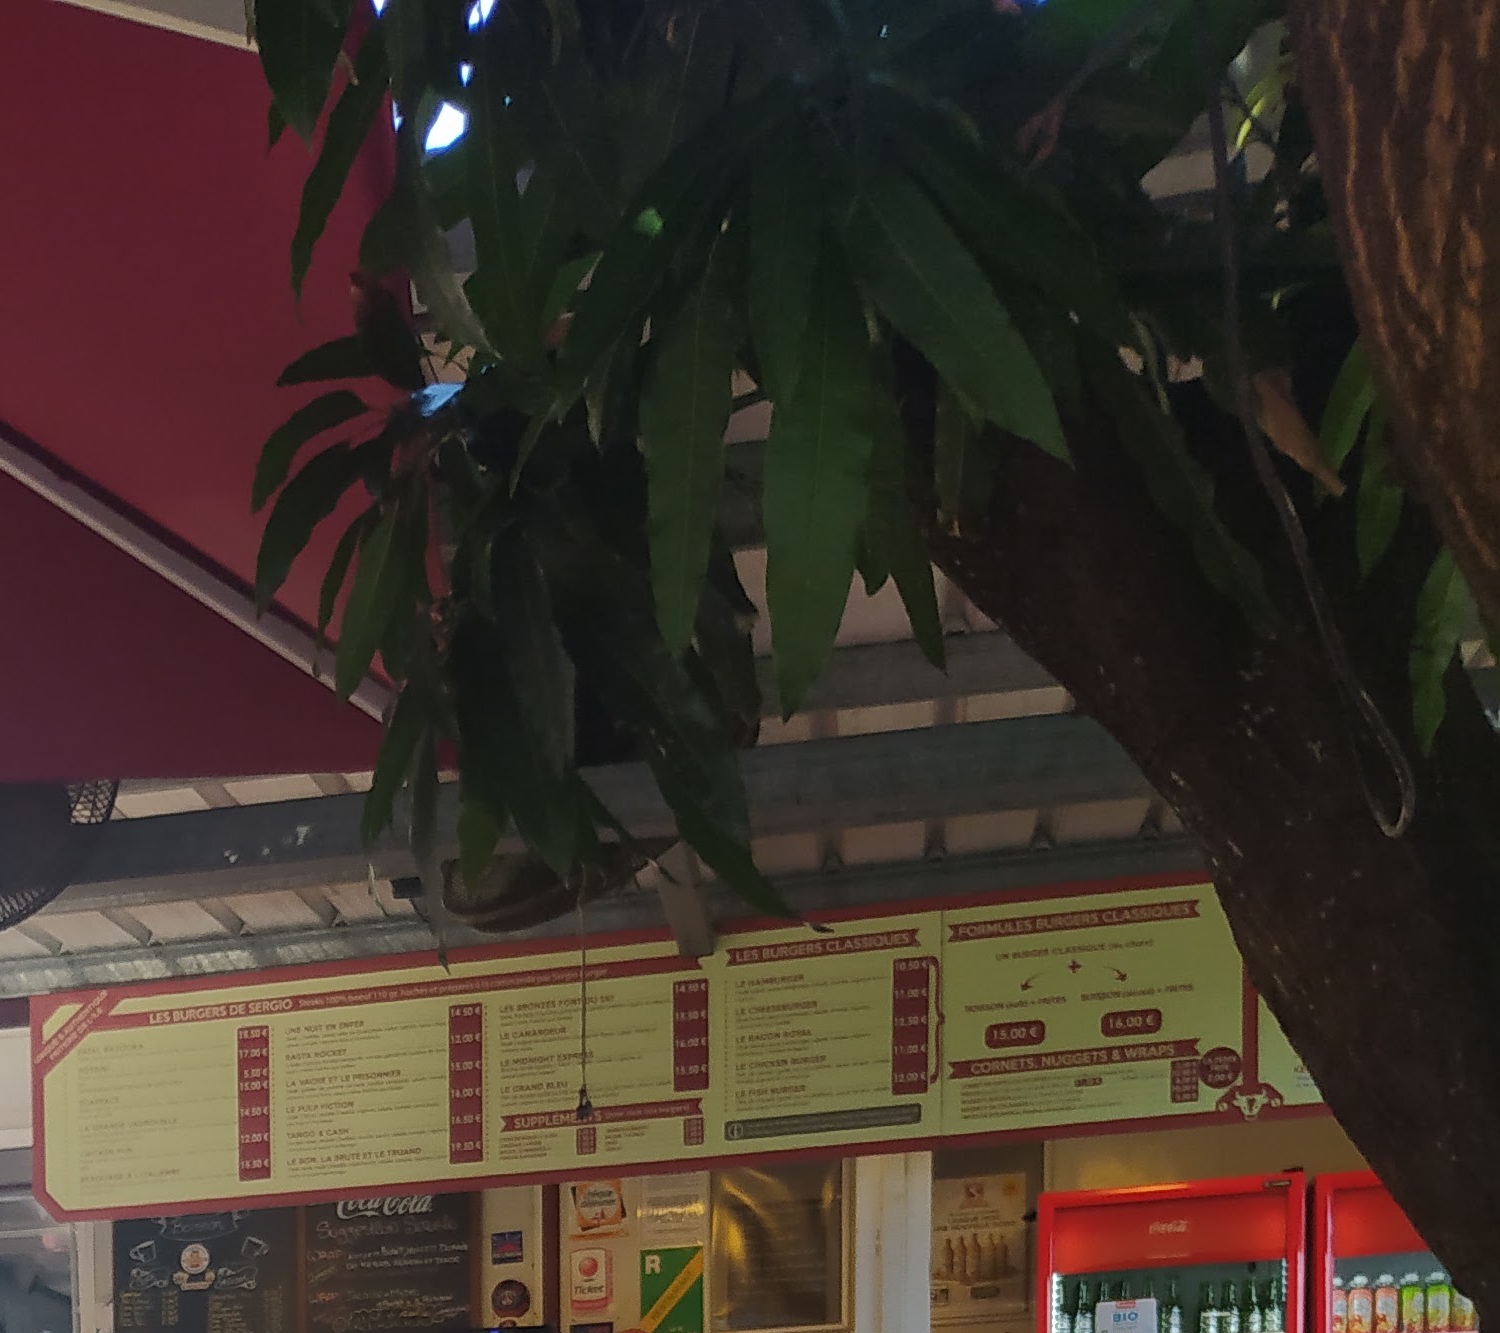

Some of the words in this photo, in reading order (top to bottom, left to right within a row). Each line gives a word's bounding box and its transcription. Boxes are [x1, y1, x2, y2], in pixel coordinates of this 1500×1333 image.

[736, 951, 759, 962] LES
[762, 941, 824, 958] BURGERS
[826, 932, 910, 952] CLASSIQUES
[150, 1011, 170, 1024] LES
[173, 1005, 227, 1021] BURGERS
[229, 1004, 246, 1016] DE
[249, 999, 293, 1013] SERGIO
[1109, 1017, 1143, 1028] 16.00
[992, 1029, 1026, 1040] 15.00
[1041, 1050, 1105, 1068] NUGGETS
[1107, 1049, 1120, 1061] &
[1123, 1044, 1175, 1059] WRAPS
[645, 1254, 661, 1275] R
[1112, 1311, 1139, 1323] BIO
